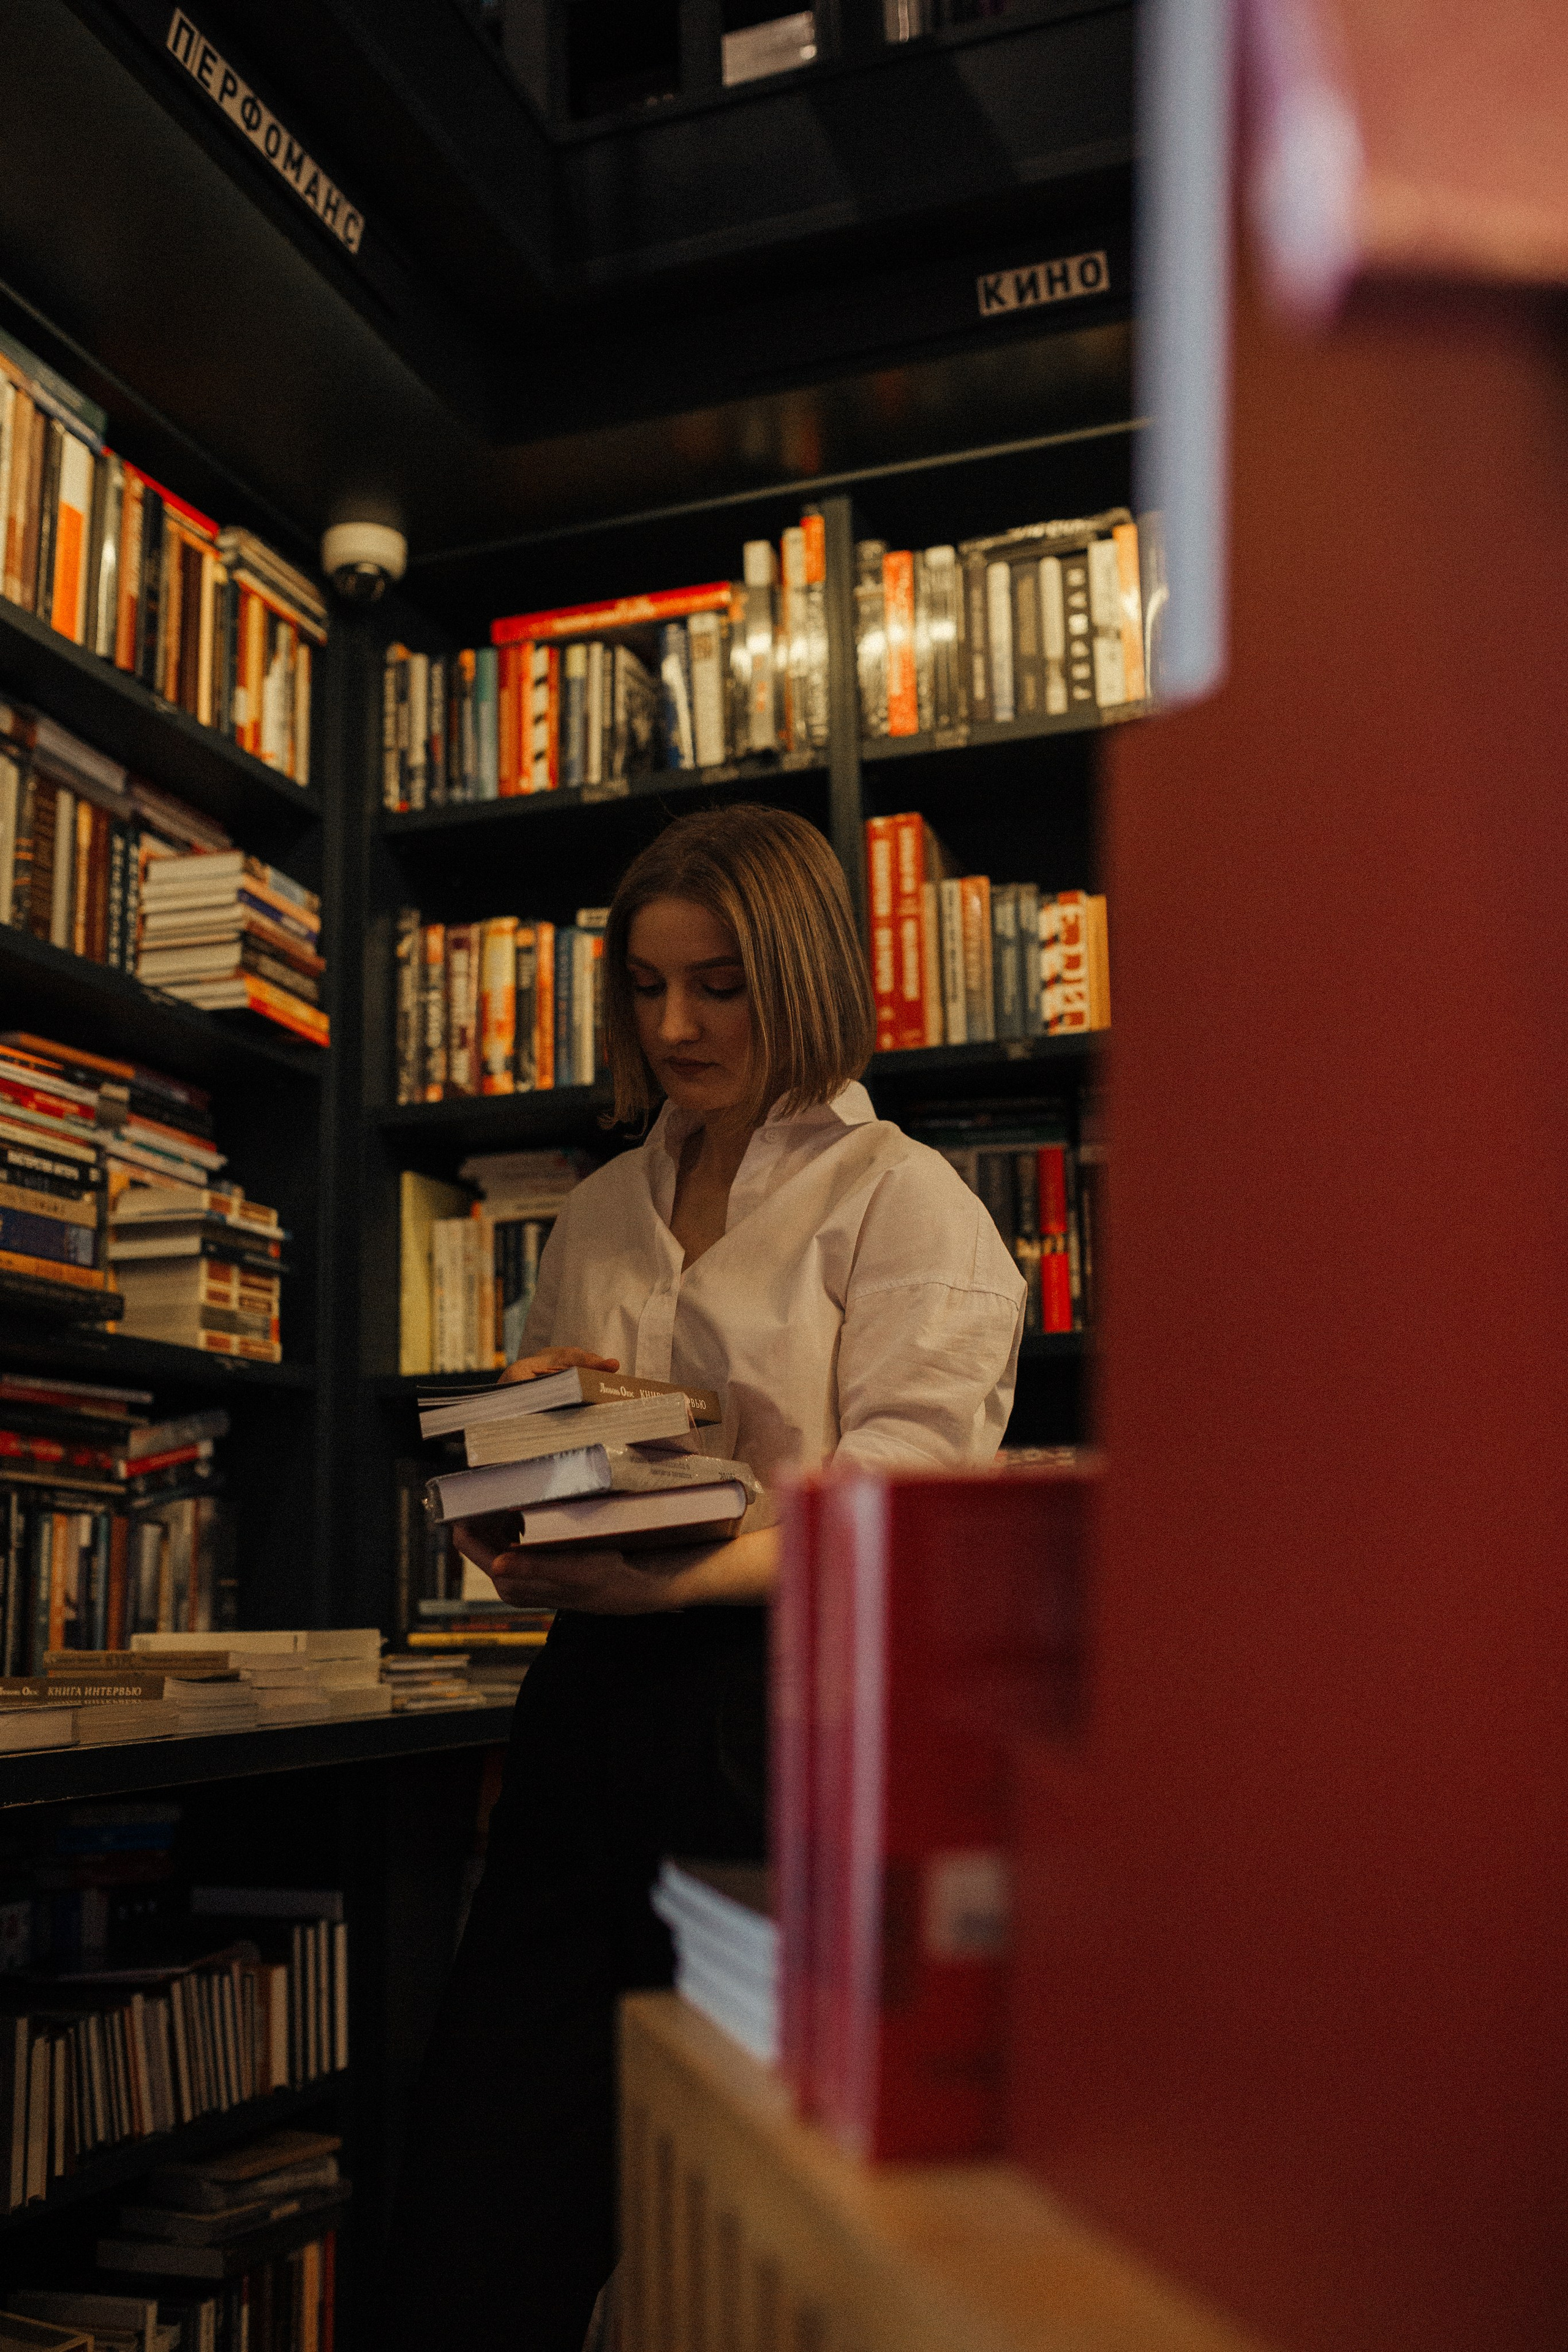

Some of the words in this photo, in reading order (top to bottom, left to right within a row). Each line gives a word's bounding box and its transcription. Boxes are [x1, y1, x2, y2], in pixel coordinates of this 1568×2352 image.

[172, 17, 360, 245] ПЕРФОМАНС
[984, 257, 1101, 309] КИНО
[47, 1686, 82, 1696] КНИГА
[85, 1686, 142, 1696] ИНТЕРВЬЮ
